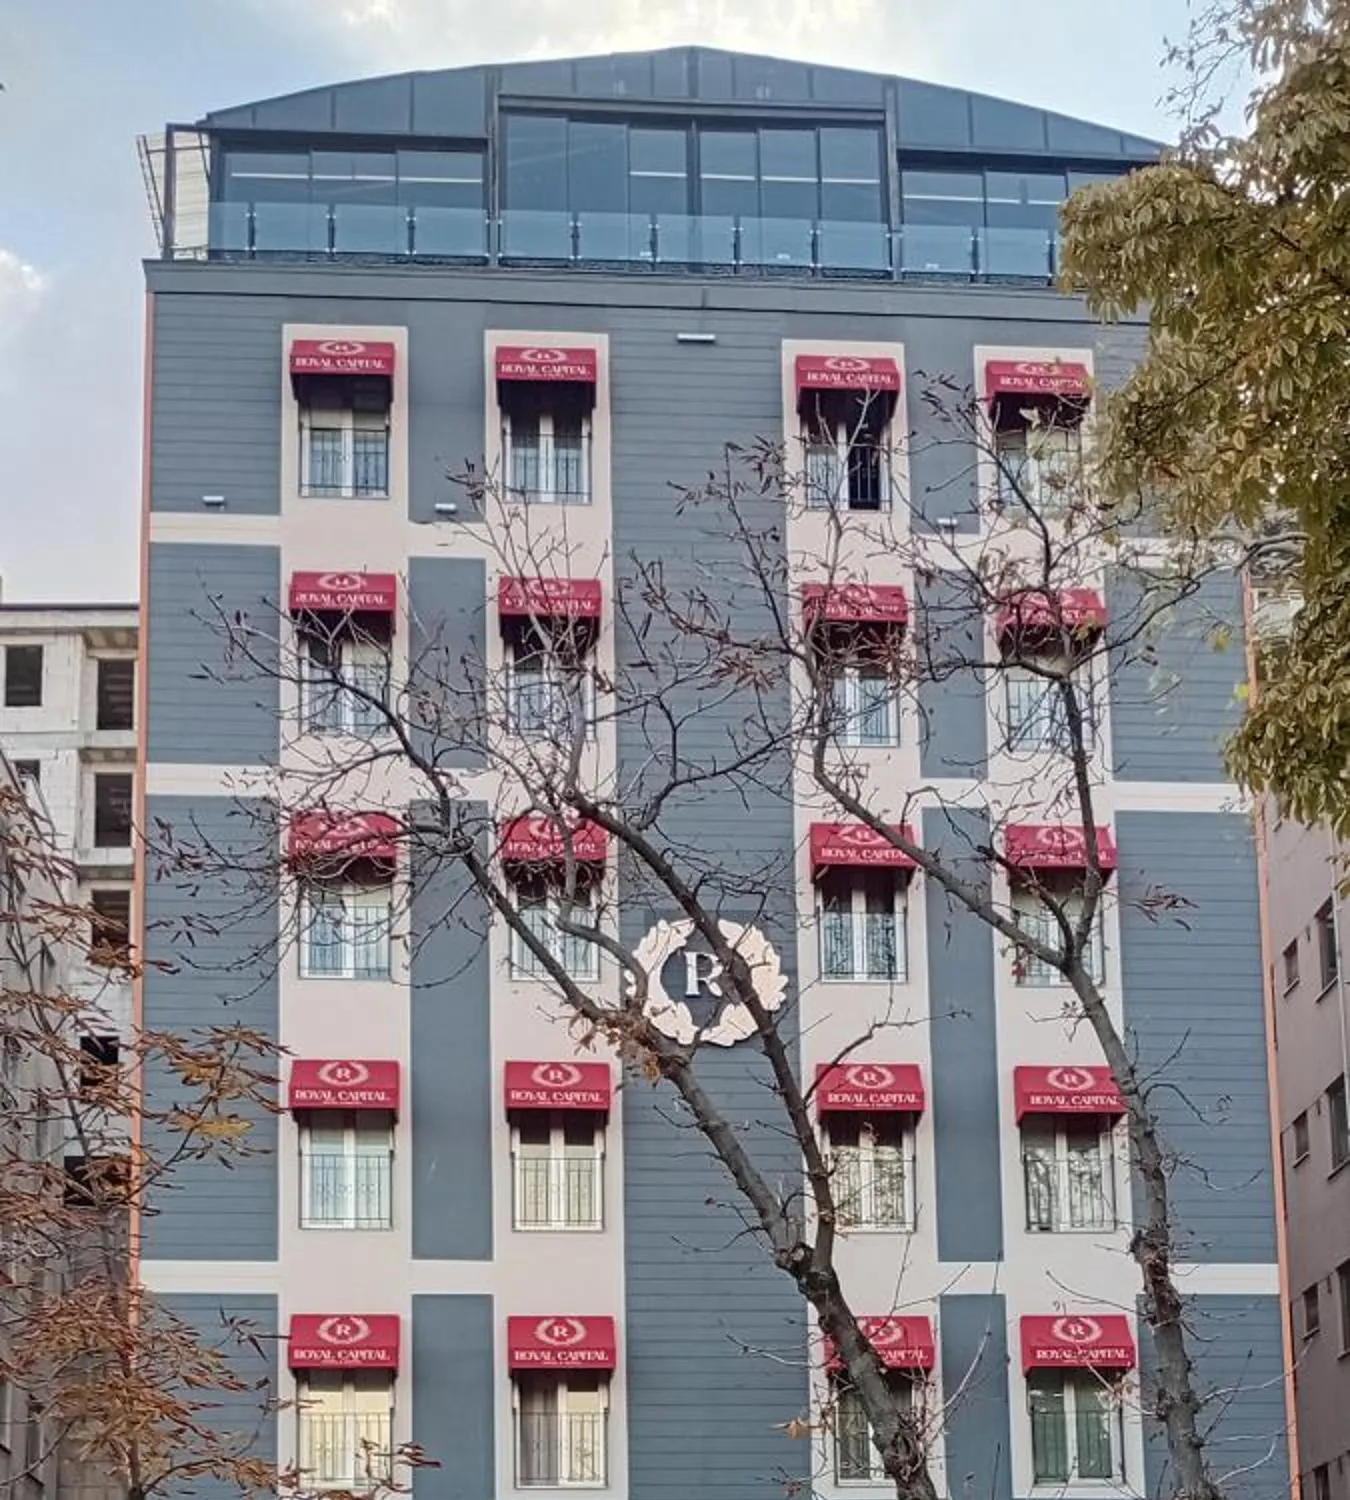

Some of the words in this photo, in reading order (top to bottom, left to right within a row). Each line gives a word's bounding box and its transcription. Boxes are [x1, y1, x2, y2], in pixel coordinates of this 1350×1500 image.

[684, 951, 723, 997] R
[295, 1089, 336, 1101] ROYAL
[337, 1090, 391, 1102] CAPITAL
[510, 1090, 550, 1101] ROYAL
[551, 1091, 604, 1102] CAPITAL
[827, 1092, 867, 1103] ROYAL
[868, 1093, 920, 1103] CAPITAL
[1030, 1095, 1070, 1105] ROYAL
[1071, 1095, 1119, 1105] CAPITAL
[293, 1349, 336, 1361] ROYAL
[337, 1350, 391, 1361] CAPITAL
[513, 1350, 556, 1361] ROYAL
[557, 1350, 609, 1361] CAPITAL
